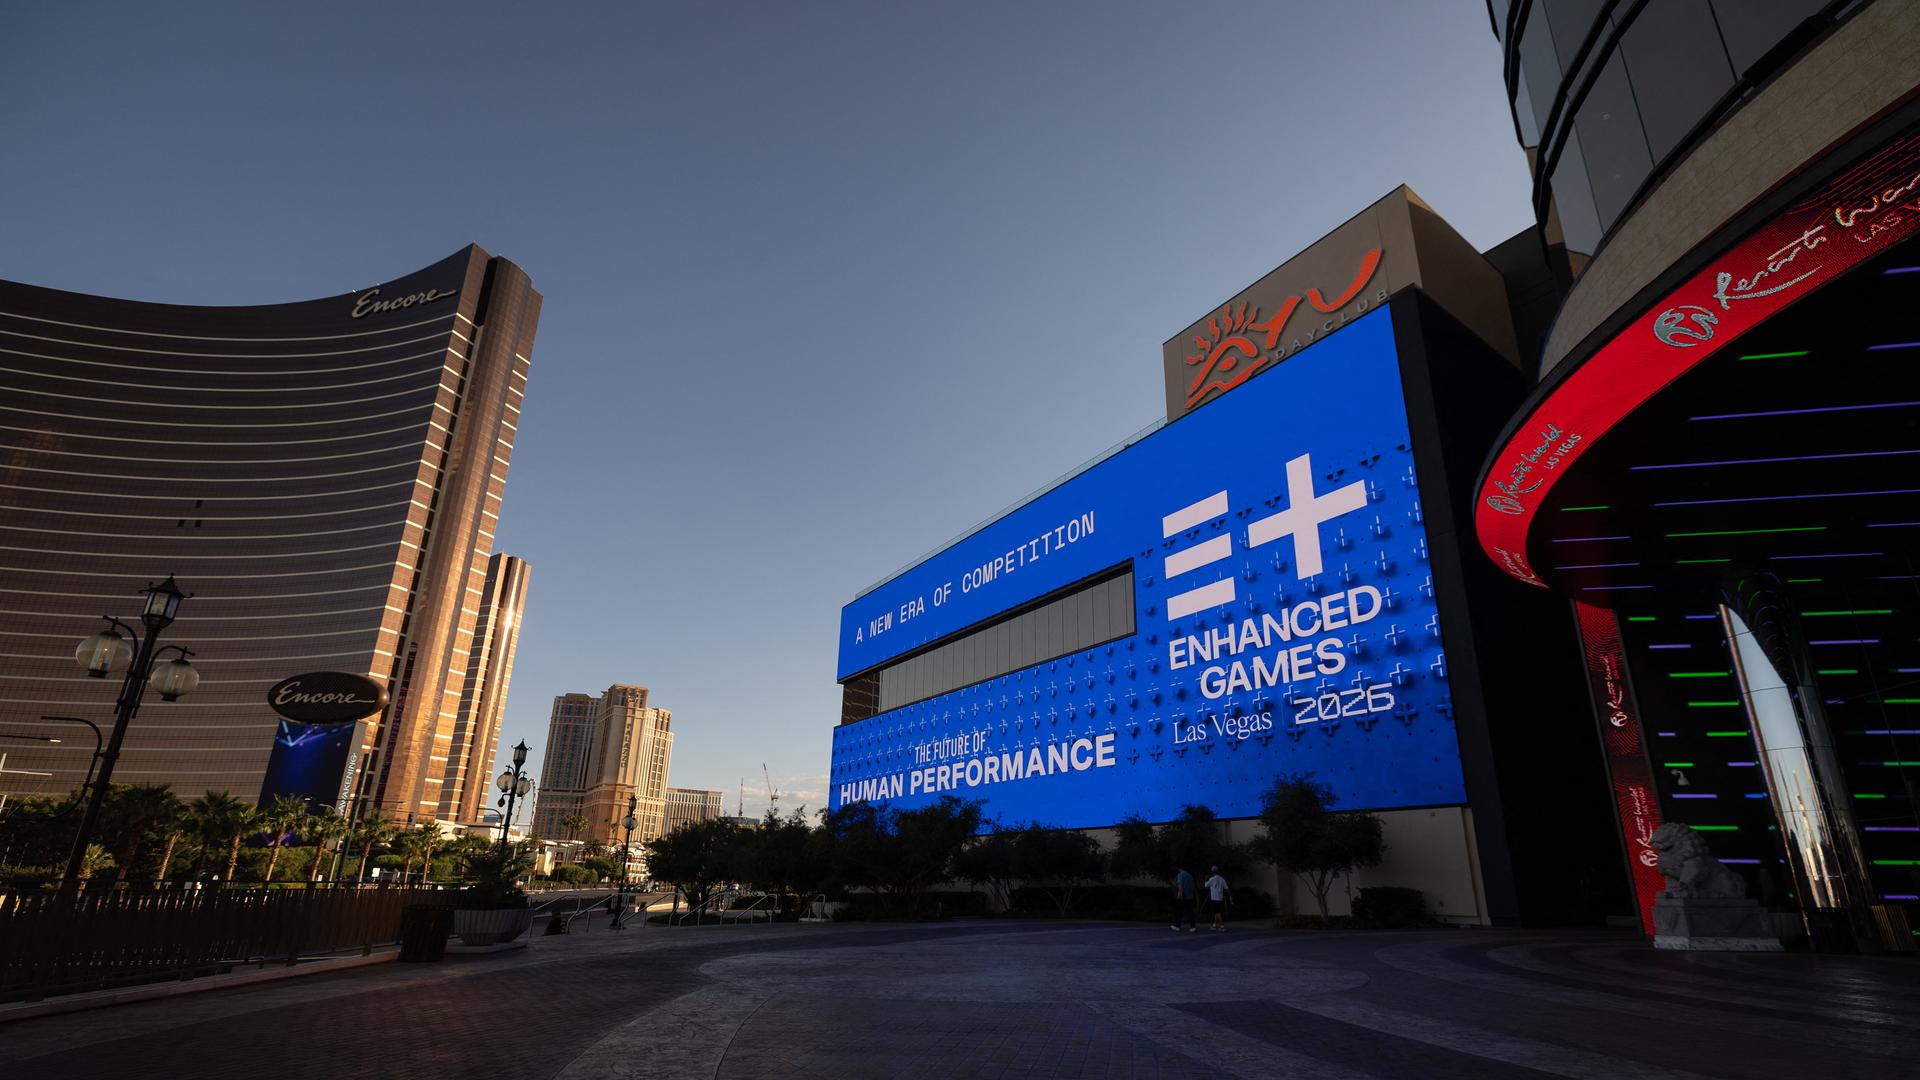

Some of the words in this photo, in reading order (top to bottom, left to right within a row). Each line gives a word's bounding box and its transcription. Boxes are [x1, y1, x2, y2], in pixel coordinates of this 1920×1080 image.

[1854, 212, 1902, 243] LAS
[352, 288, 457, 318] Encore
[1275, 289, 1389, 360] DAYCLUB
[1544, 456, 1560, 470] LAS
[1554, 433, 1582, 457] VEGAS
[855, 627, 863, 645] A
[869, 611, 893, 637] NEW
[900, 596, 925, 624] ERA
[933, 582, 952, 607] OF
[962, 510, 1095, 593] COMPETITION
[1169, 585, 1382, 670] ENHANCED
[275, 681, 376, 705] Encore
[1200, 637, 1346, 699] GAMES
[1173, 721, 1207, 745] Las
[1211, 711, 1273, 740] Vegas
[1293, 682, 1395, 725] 2026
[620, 723, 632, 768] PALAZZO
[840, 773, 904, 805] HUMAN
[910, 733, 1116, 796] PERFORMANCE
[915, 745, 931, 764] THE
[933, 734, 970, 762] FUTURE
[972, 731, 986, 751] OF
[338, 752, 358, 817] AWAKENING
